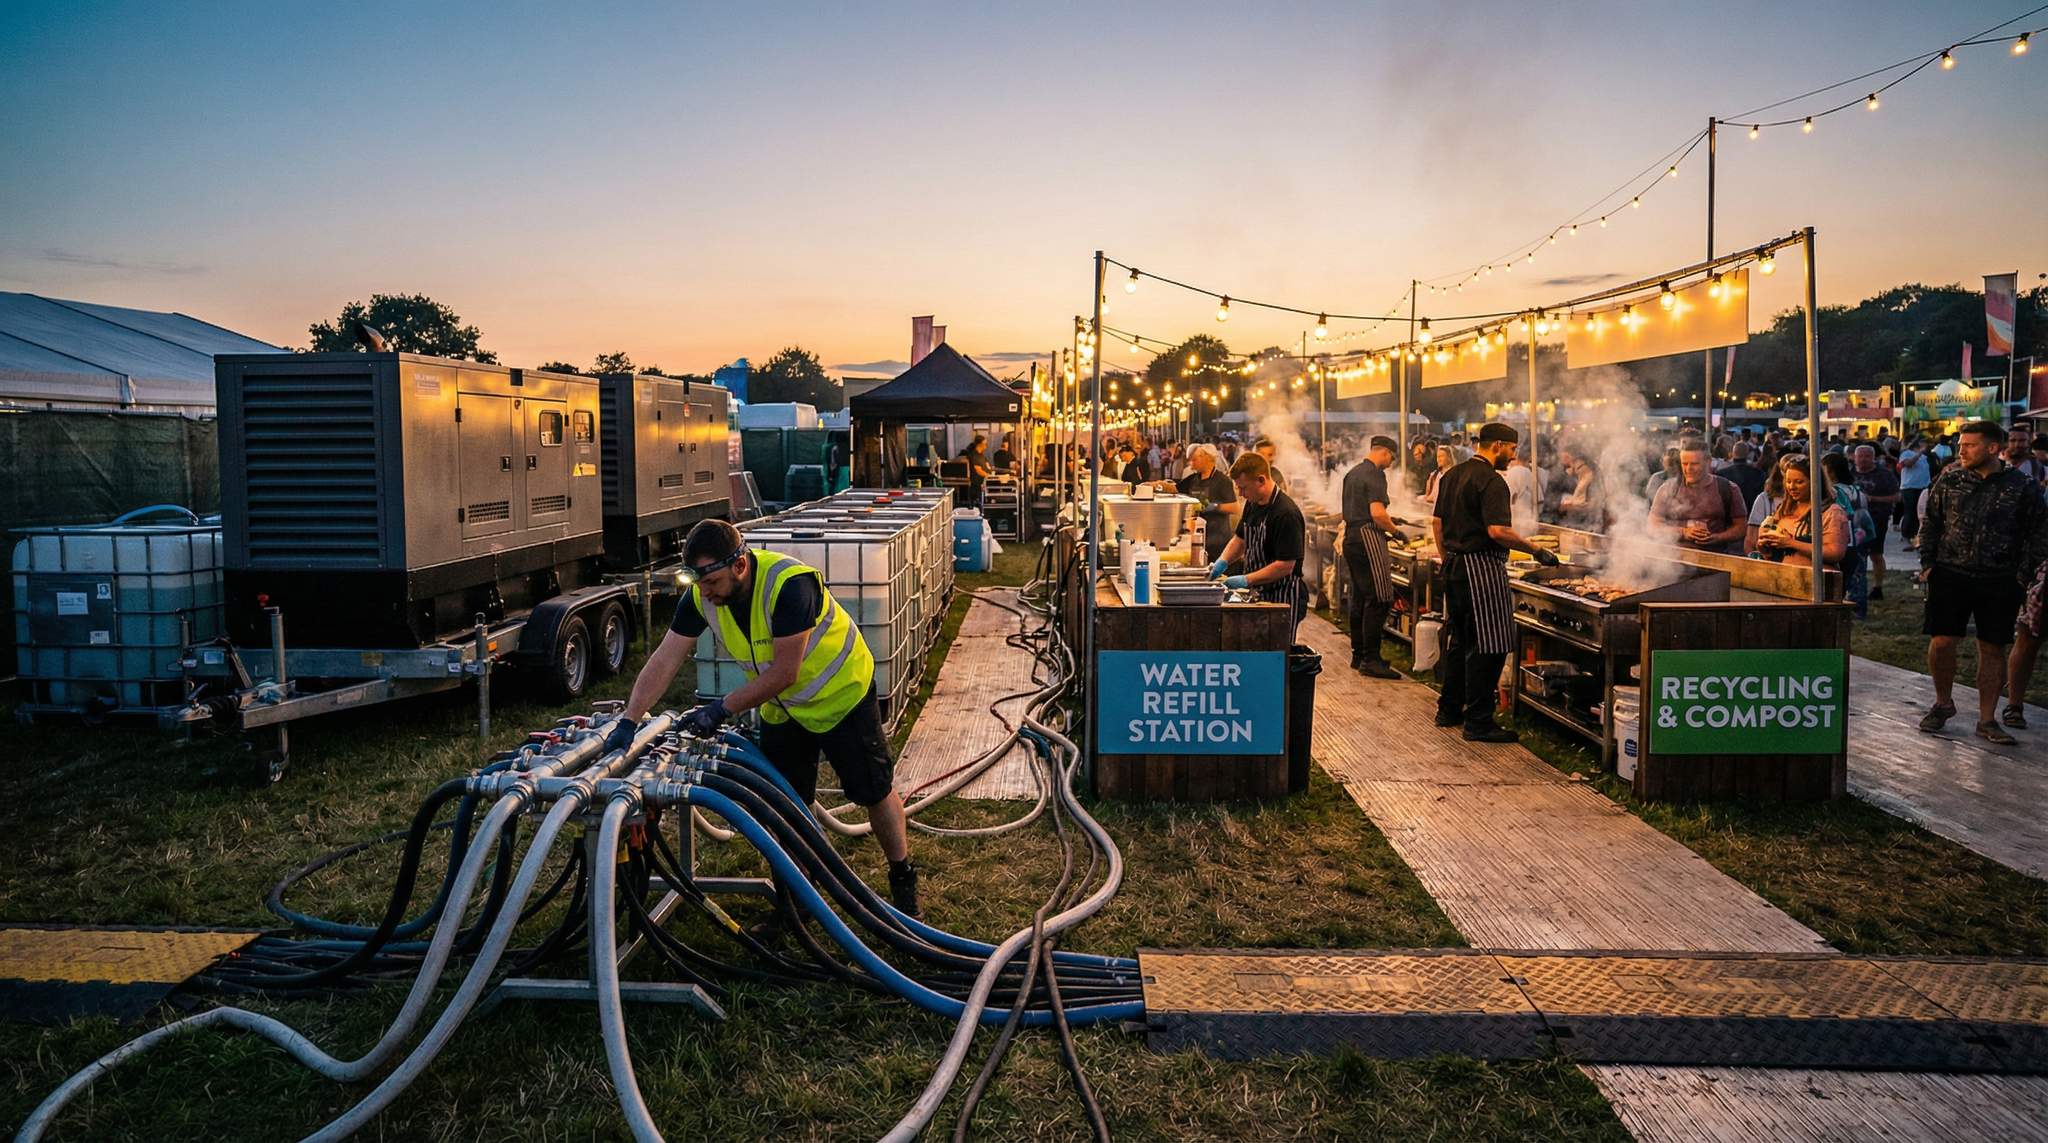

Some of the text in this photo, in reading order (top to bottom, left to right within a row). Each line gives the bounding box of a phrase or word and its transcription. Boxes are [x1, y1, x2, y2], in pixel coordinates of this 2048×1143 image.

[1140, 663, 1241, 687] WATER
[1661, 676, 1833, 700] RECYCLING
[1143, 691, 1241, 715] REFILL
[1657, 705, 1836, 728] & COMPOST
[1128, 719, 1253, 743] STATION
